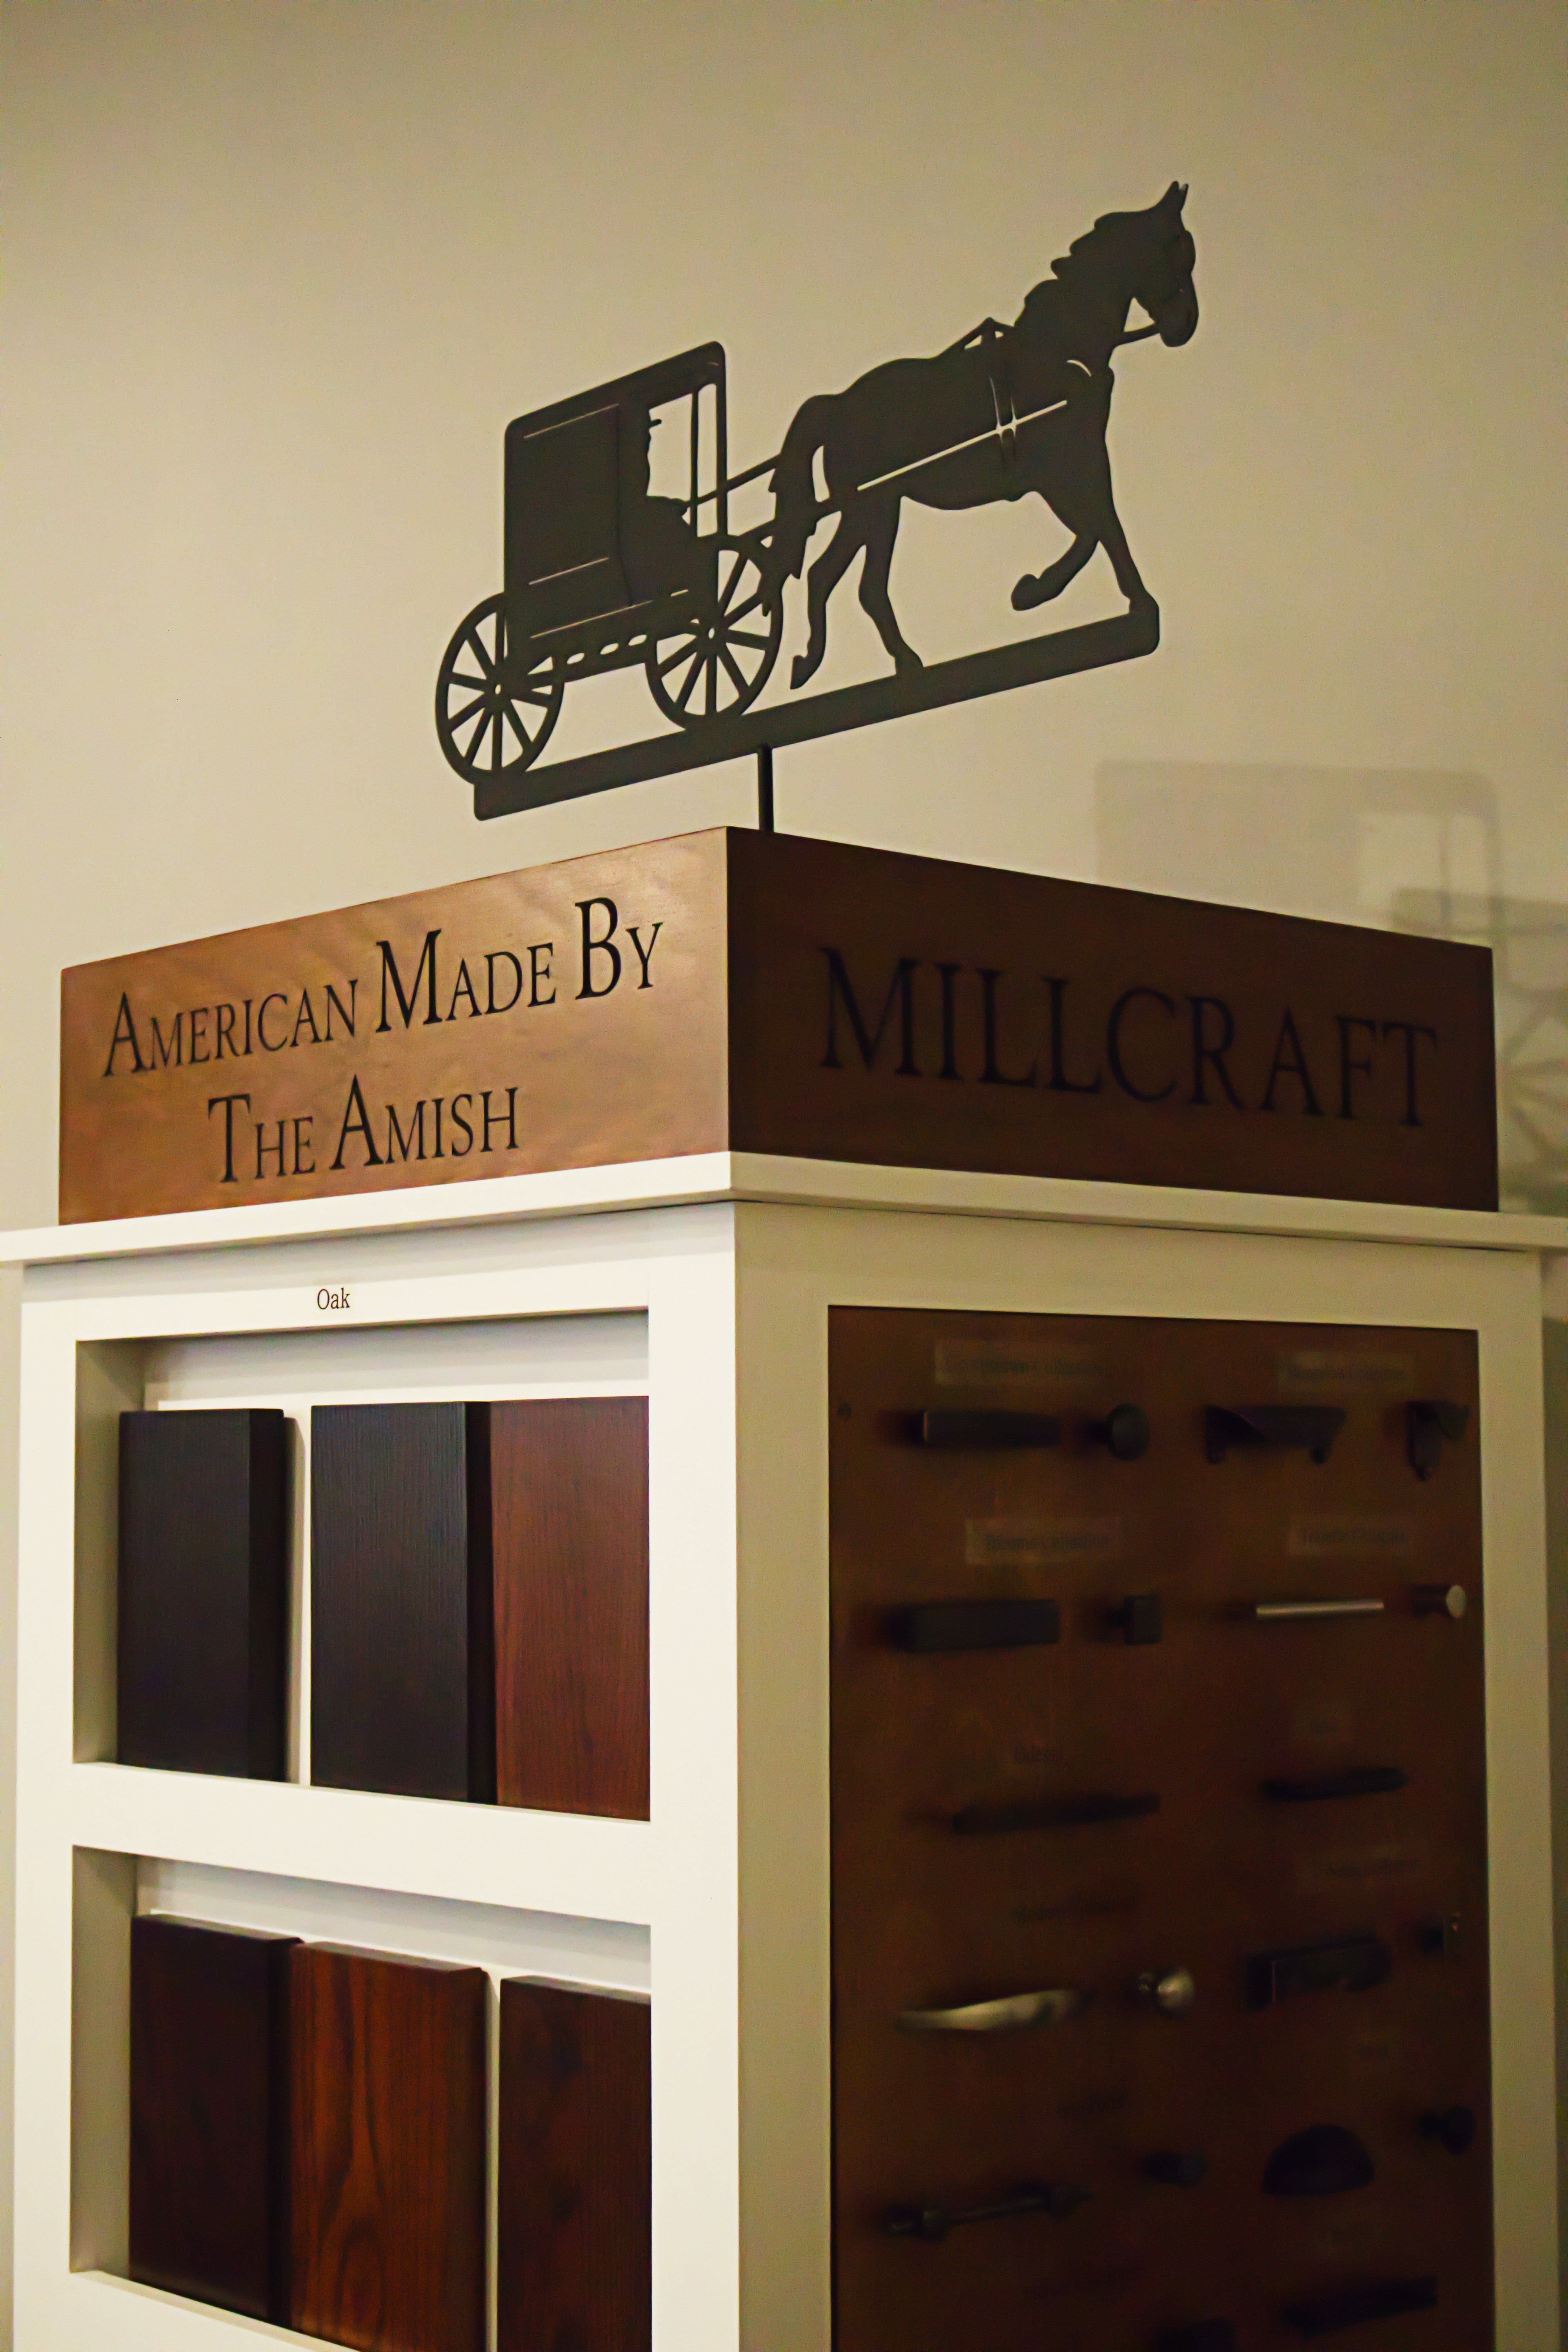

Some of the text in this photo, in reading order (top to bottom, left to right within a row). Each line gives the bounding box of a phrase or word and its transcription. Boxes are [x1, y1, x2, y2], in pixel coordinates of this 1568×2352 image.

[102, 897, 664, 1077] AMERICAN MADE BY
[816, 946, 1438, 1127] MILLCRAFT
[207, 1074, 519, 1184] THE AMISH
[317, 1287, 350, 1310] Oak
